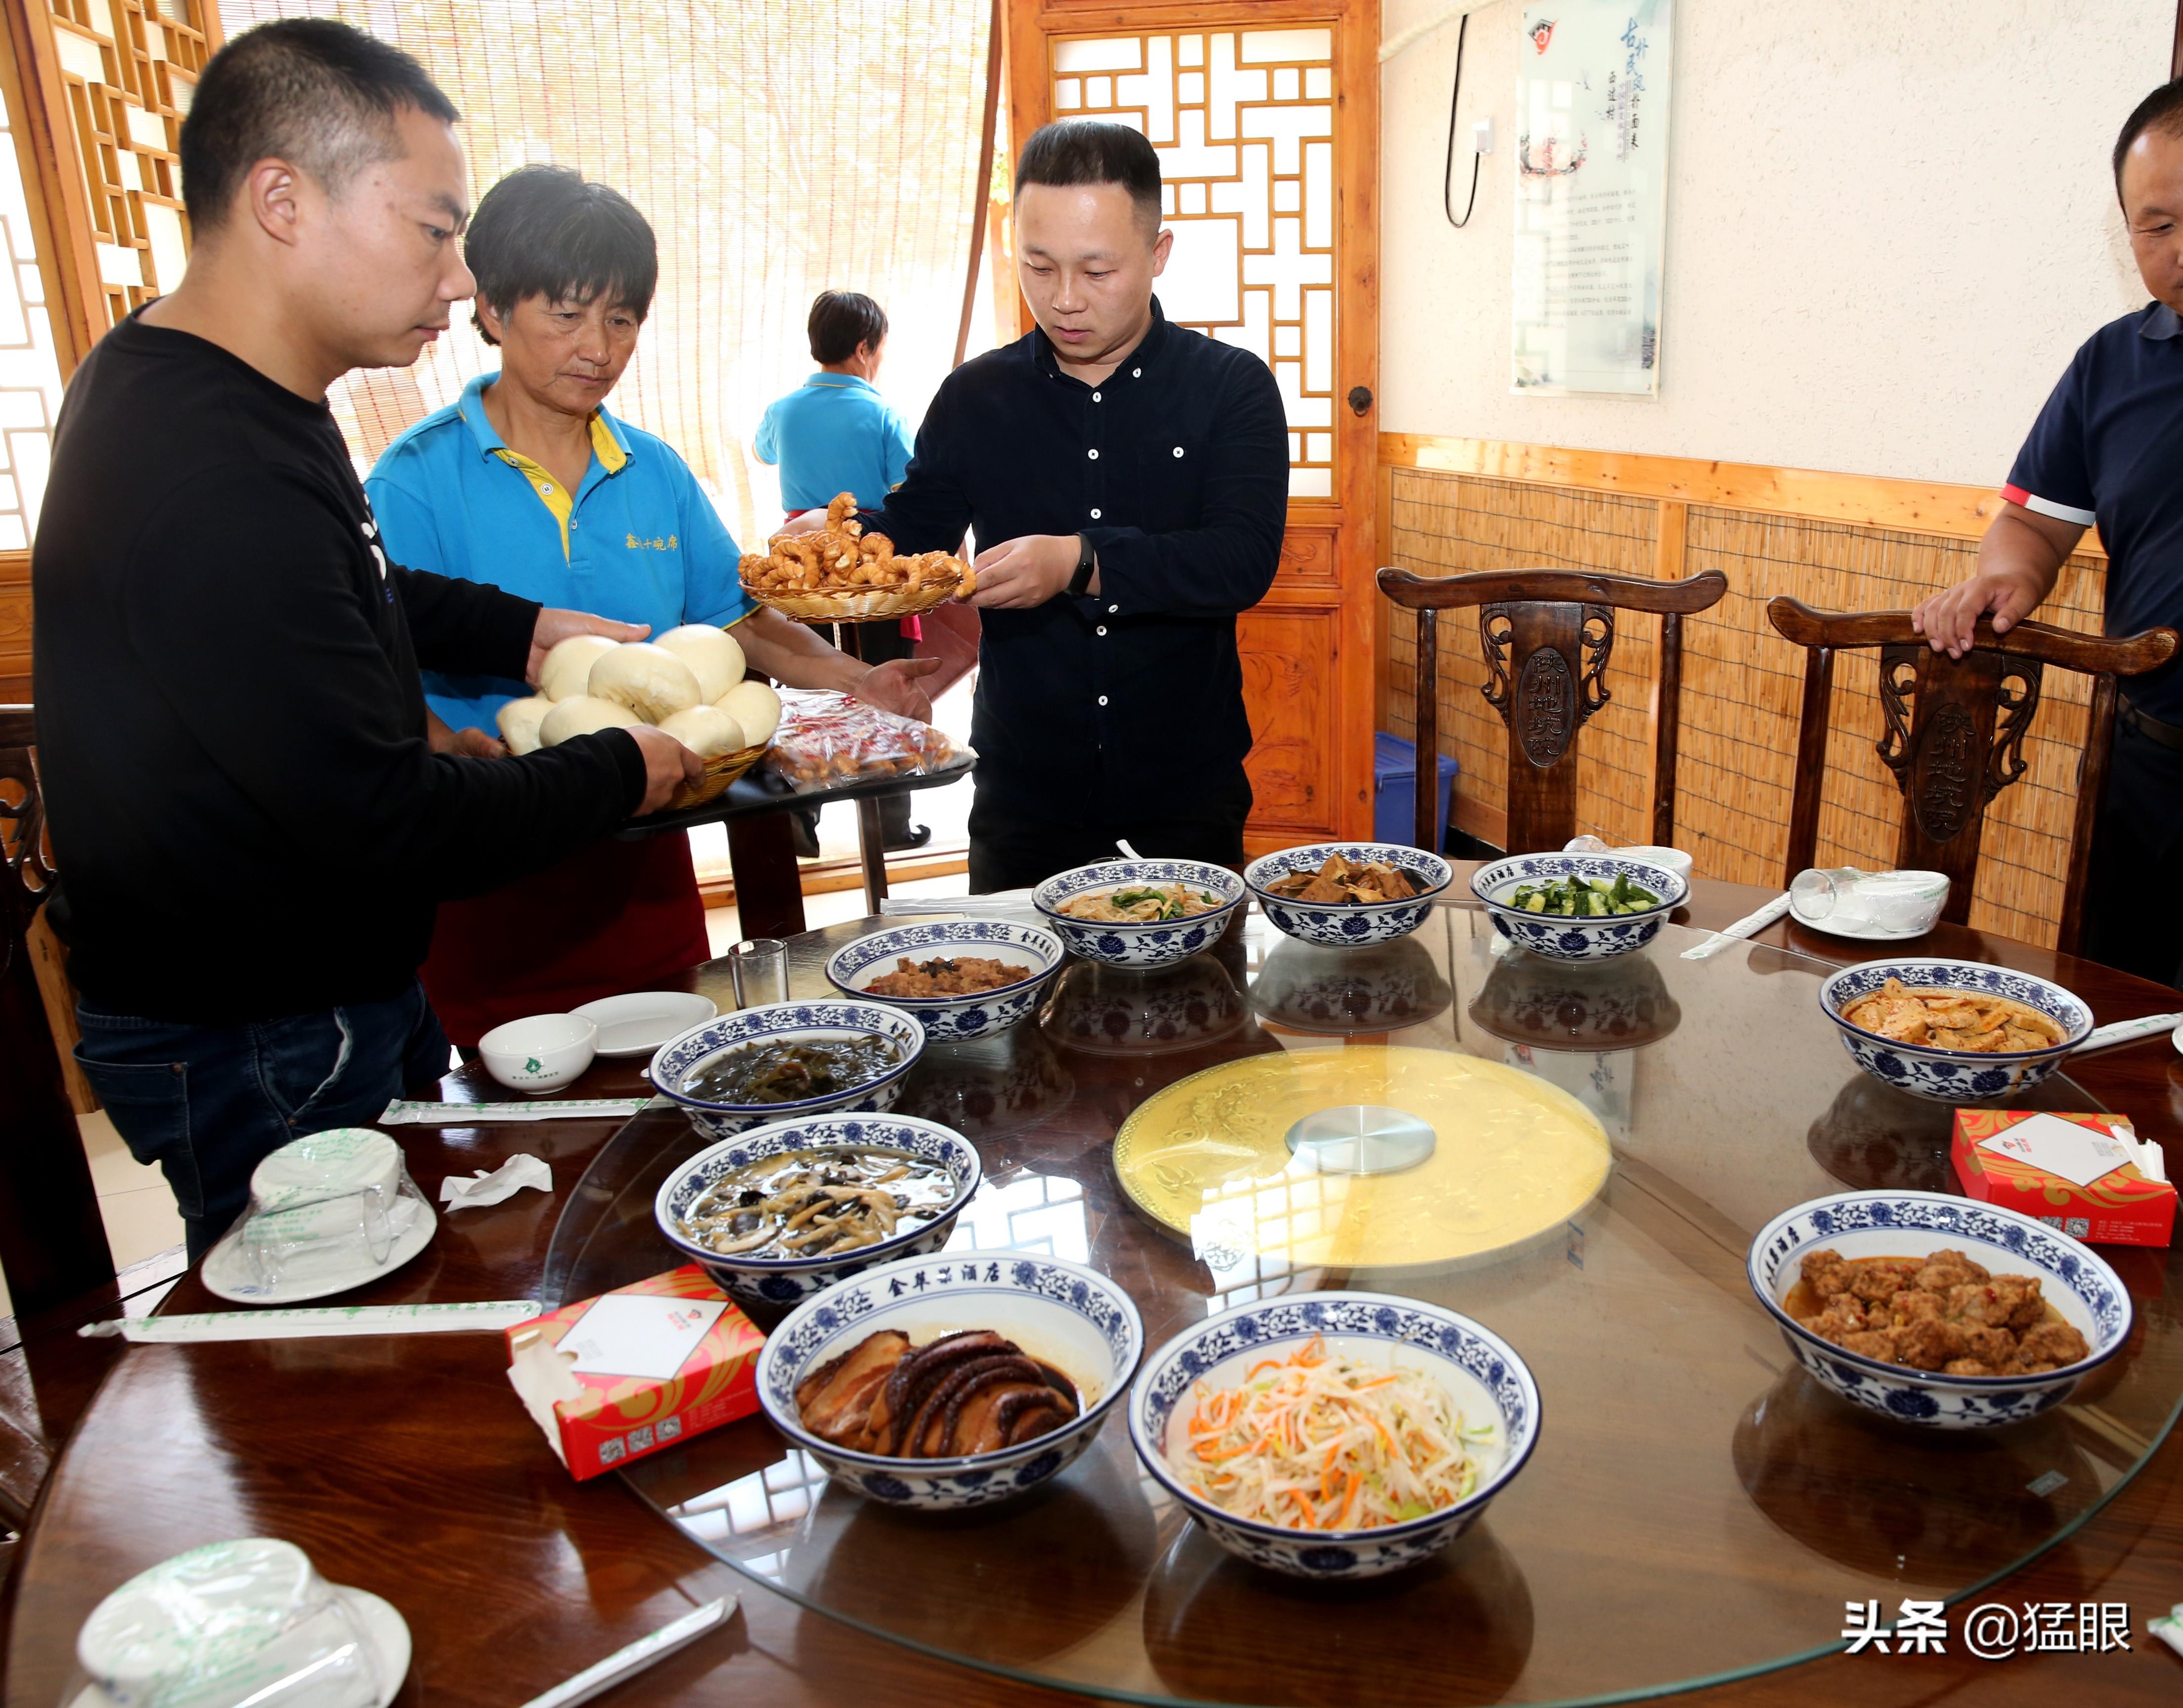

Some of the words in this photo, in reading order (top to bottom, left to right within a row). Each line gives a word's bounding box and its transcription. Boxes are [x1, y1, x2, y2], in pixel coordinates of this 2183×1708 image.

[1528, 654, 1567, 757] 陕州地坑院
[1924, 713, 1976, 831] 陕州地坑院
